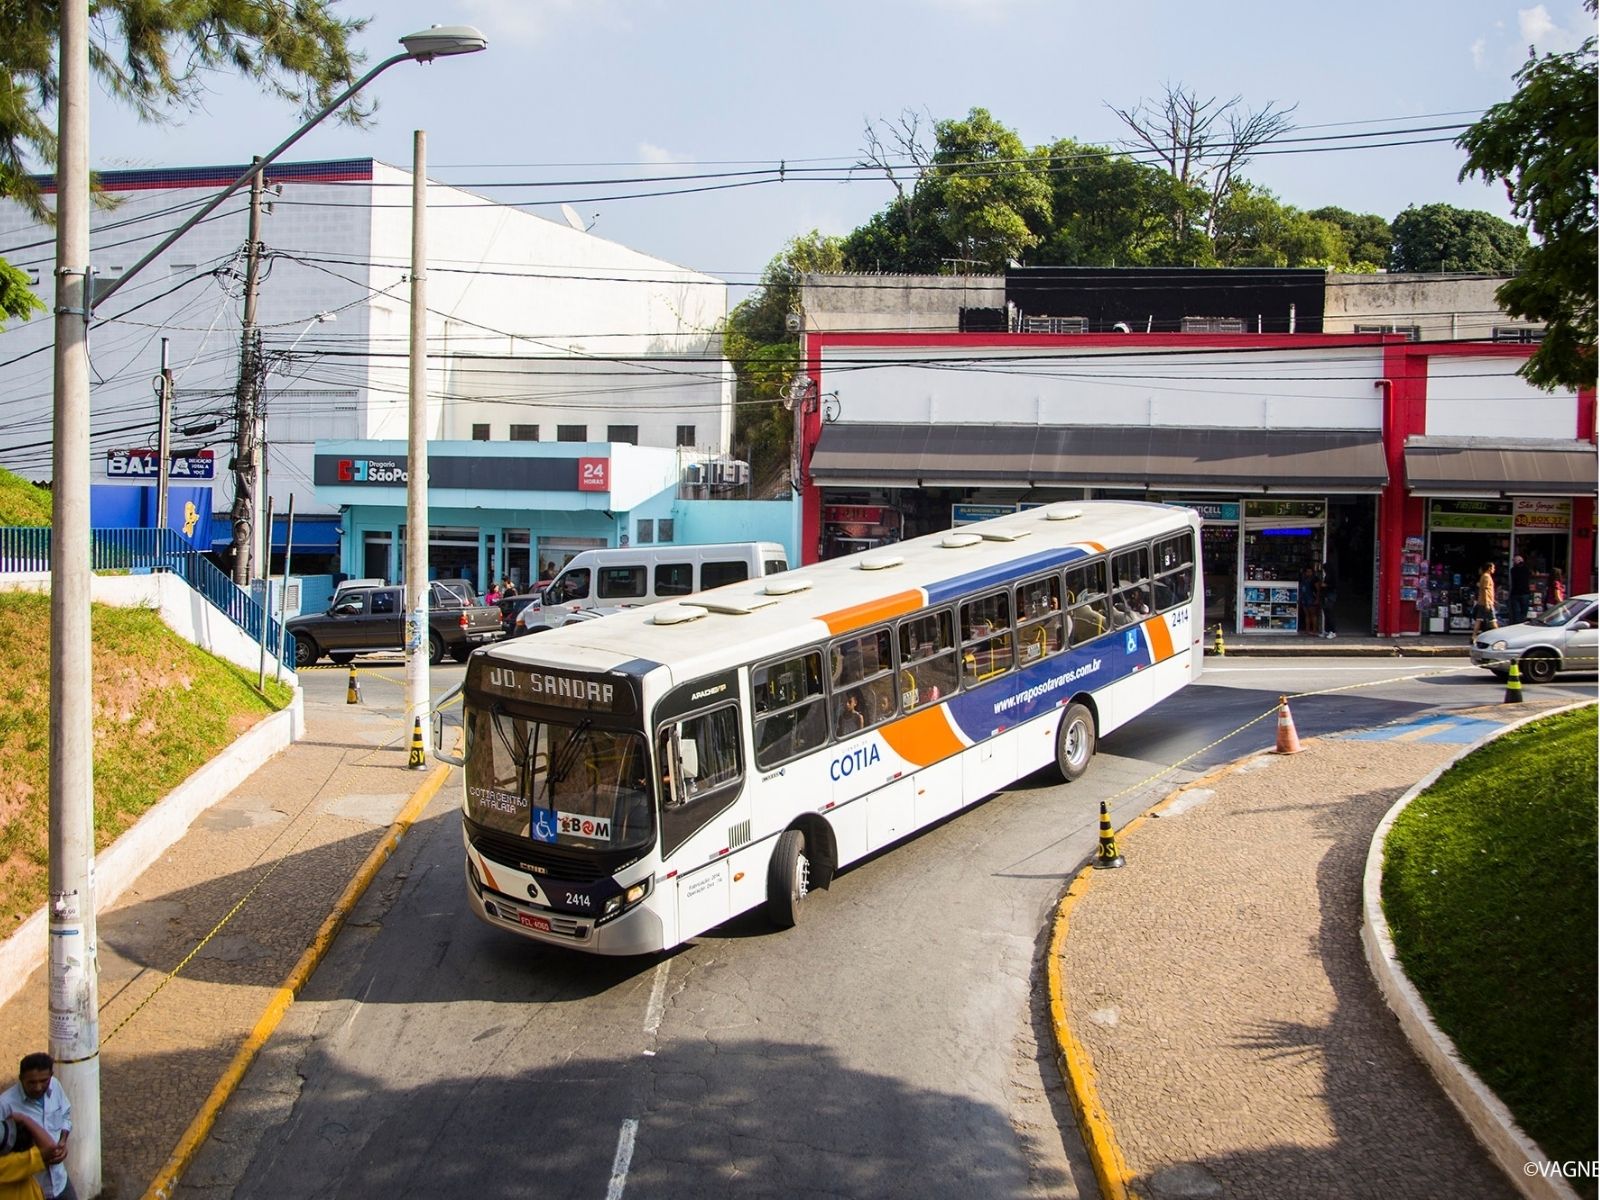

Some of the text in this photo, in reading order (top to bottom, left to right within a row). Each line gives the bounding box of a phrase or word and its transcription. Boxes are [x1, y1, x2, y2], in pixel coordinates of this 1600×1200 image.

[368, 460, 395, 468] Drogaria
[583, 463, 604, 478] 24
[1518, 501, 1534, 510] São
[1535, 501, 1555, 511] Jorge
[1172, 607, 1189, 627] 2414
[490, 667, 614, 703] JD. SANDRA
[993, 659, 1102, 714] www.vraposotavares.com.br
[830, 743, 880, 781] COTIA
[470, 786, 528, 808] COTIA CENTRO
[480, 798, 517, 815] ATALAIA
[565, 892, 592, 907] 2414
